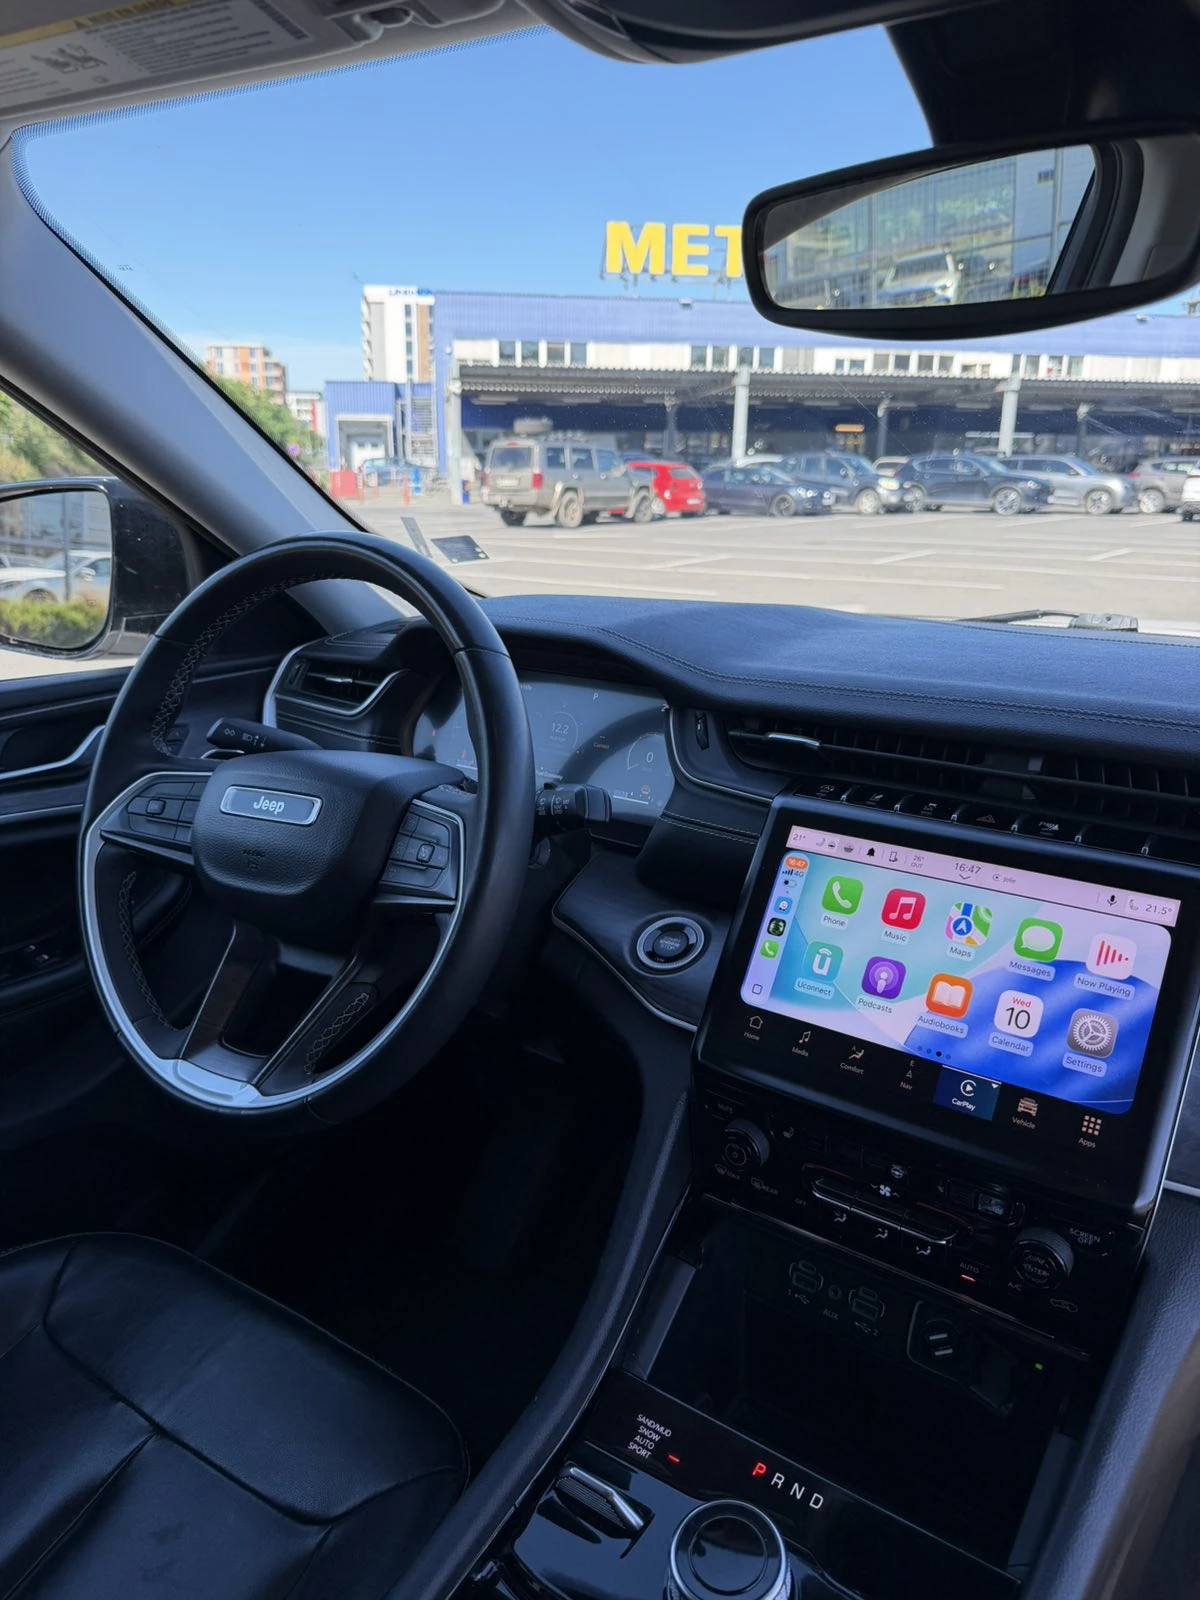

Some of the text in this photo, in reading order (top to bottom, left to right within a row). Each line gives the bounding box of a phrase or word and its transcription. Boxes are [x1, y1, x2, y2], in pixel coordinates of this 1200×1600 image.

[253, 795, 285, 815] Jeep
[954, 862, 981, 875] 16:47
[823, 915, 846, 927] Phone
[883, 930, 907, 942] Music
[949, 946, 972, 959] Maps
[1008, 960, 1052, 978] Messages
[797, 977, 832, 997] Uconnect
[1077, 977, 1131, 998] Now Playing
[857, 998, 893, 1014] Podcasts
[1012, 996, 1032, 1008] Wed
[917, 1015, 964, 1034] Audiobooks
[1005, 1007, 1031, 1030] 10
[743, 1031, 760, 1041] Home
[791, 1046, 809, 1057] Media
[991, 1036, 1031, 1053] Calendar
[839, 1062, 865, 1075] Comfort
[1066, 1056, 1103, 1073] Settings
[900, 1081, 913, 1091] Nav
[951, 1097, 976, 1112] CarPlay
[1011, 1116, 1037, 1130] Vehicle
[1078, 1137, 1097, 1149] Apps
[1068, 1227, 1101, 1244] SCREEN
[959, 1261, 980, 1274] AUTO
[822, 1308, 840, 1320] AUX
[635, 1413, 672, 1438] SAND/MUD
[637, 1425, 662, 1442] SNOW
[627, 1441, 652, 1459] SPORT
[634, 1434, 655, 1450] AUTO
[752, 1462, 825, 1510] P R N D
